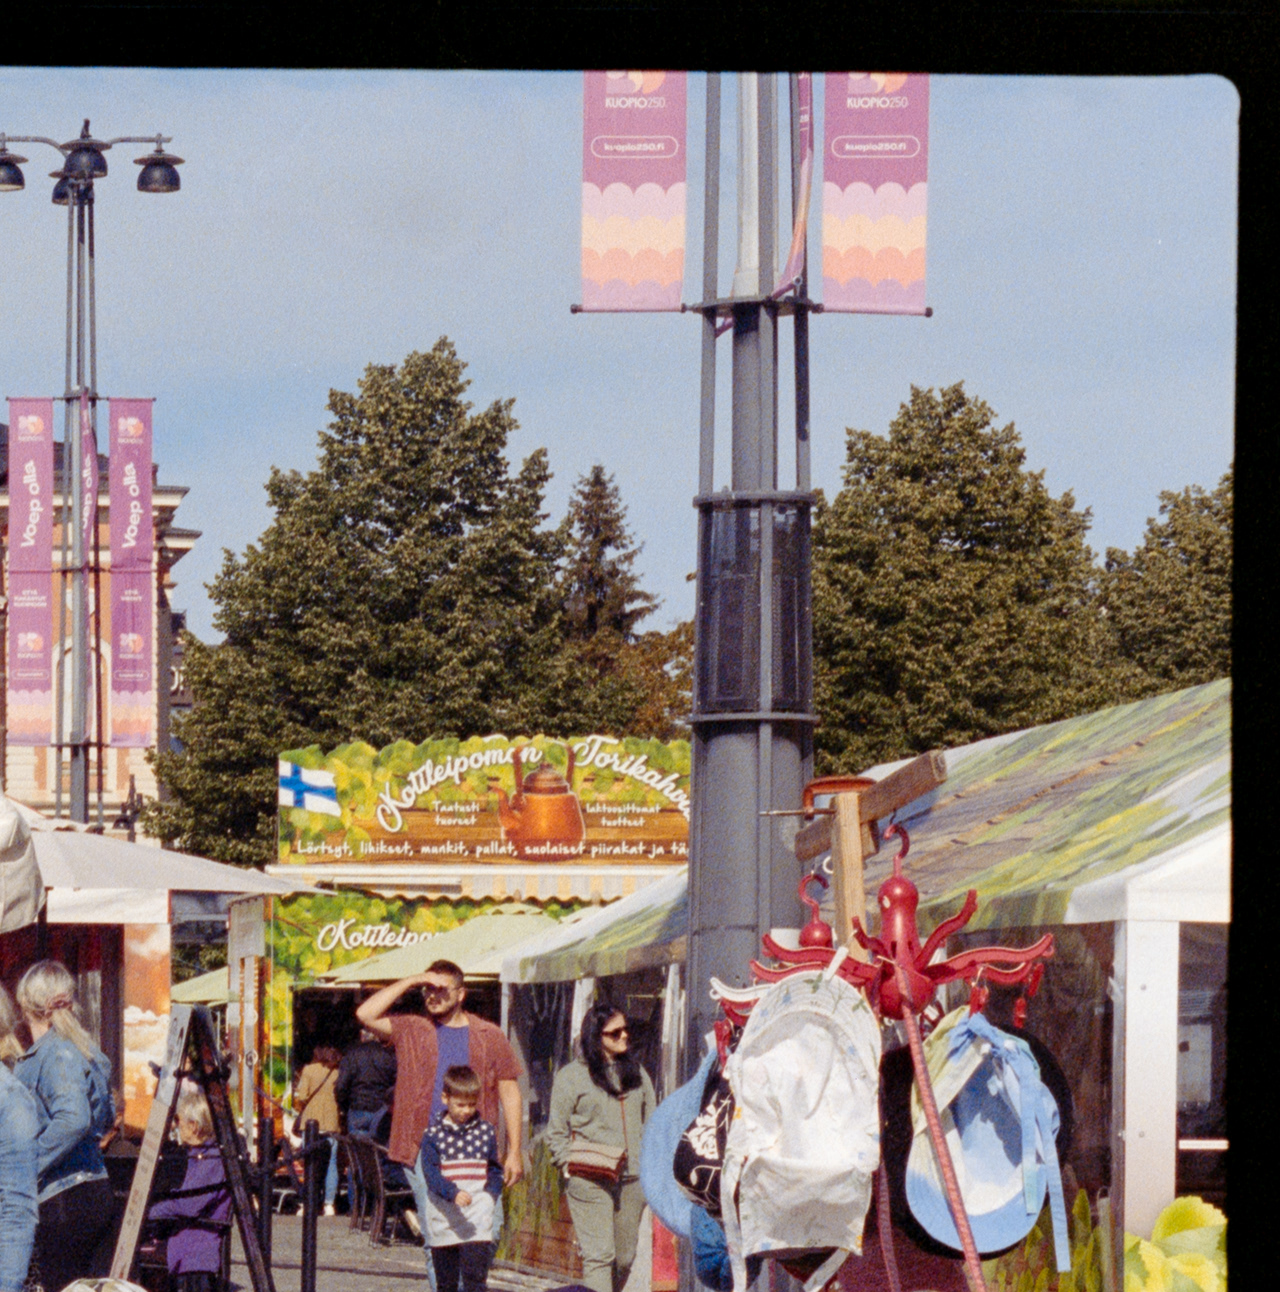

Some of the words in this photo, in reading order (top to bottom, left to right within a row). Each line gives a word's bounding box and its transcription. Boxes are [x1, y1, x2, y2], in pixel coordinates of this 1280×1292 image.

[605, 97, 666, 109] KUOPIO250
[847, 97, 908, 109] KUOPIO250
[604, 142, 665, 153] kuopio250.fi
[845, 142, 906, 153] kuopio250.fi
[23, 460, 40, 495] olla
[123, 462, 140, 497] olla
[20, 499, 44, 547] Voep
[122, 501, 144, 548] Voep
[432, 800, 480, 814] Taatusti
[435, 815, 477, 827] tuoreet
[601, 816, 646, 828] tuotteet
[421, 841, 469, 857] munkit,
[476, 841, 518, 858] pullat,
[525, 841, 586, 856] suolaiset
[591, 842, 647, 858] piirakat
[648, 843, 665, 859] ja
[671, 842, 689, 856] tä
